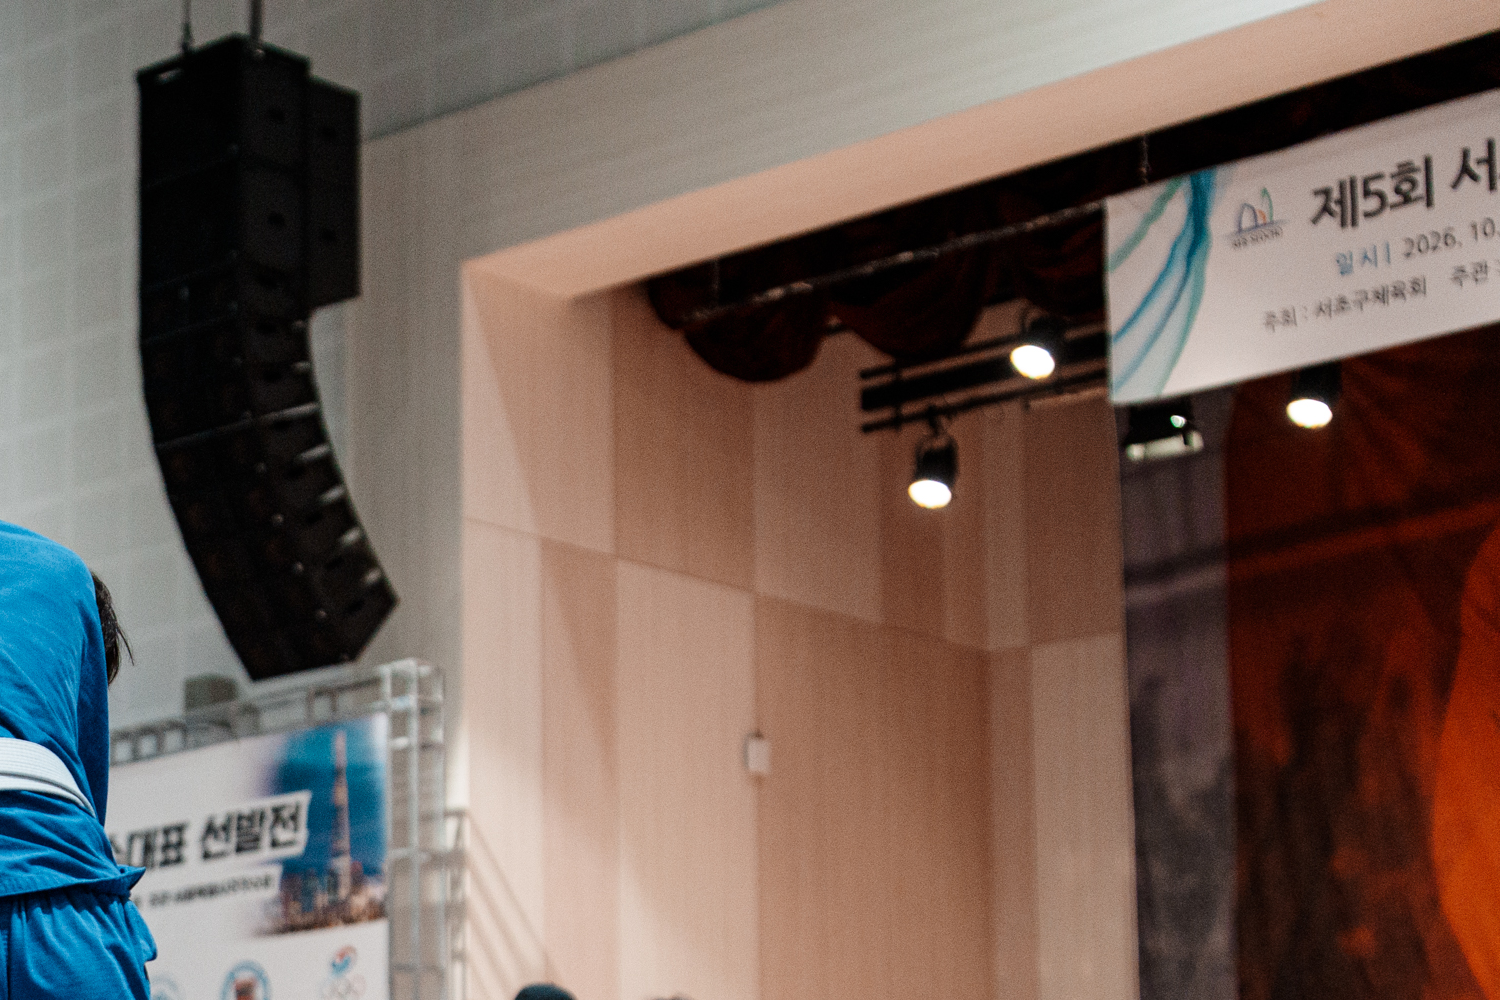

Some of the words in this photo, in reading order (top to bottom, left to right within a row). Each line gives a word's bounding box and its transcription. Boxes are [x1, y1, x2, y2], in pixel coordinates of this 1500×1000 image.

[1311, 154, 1435, 229] 제5회
[1315, 274, 1428, 319] 서초구체육회
[202, 801, 301, 860] 선발전
